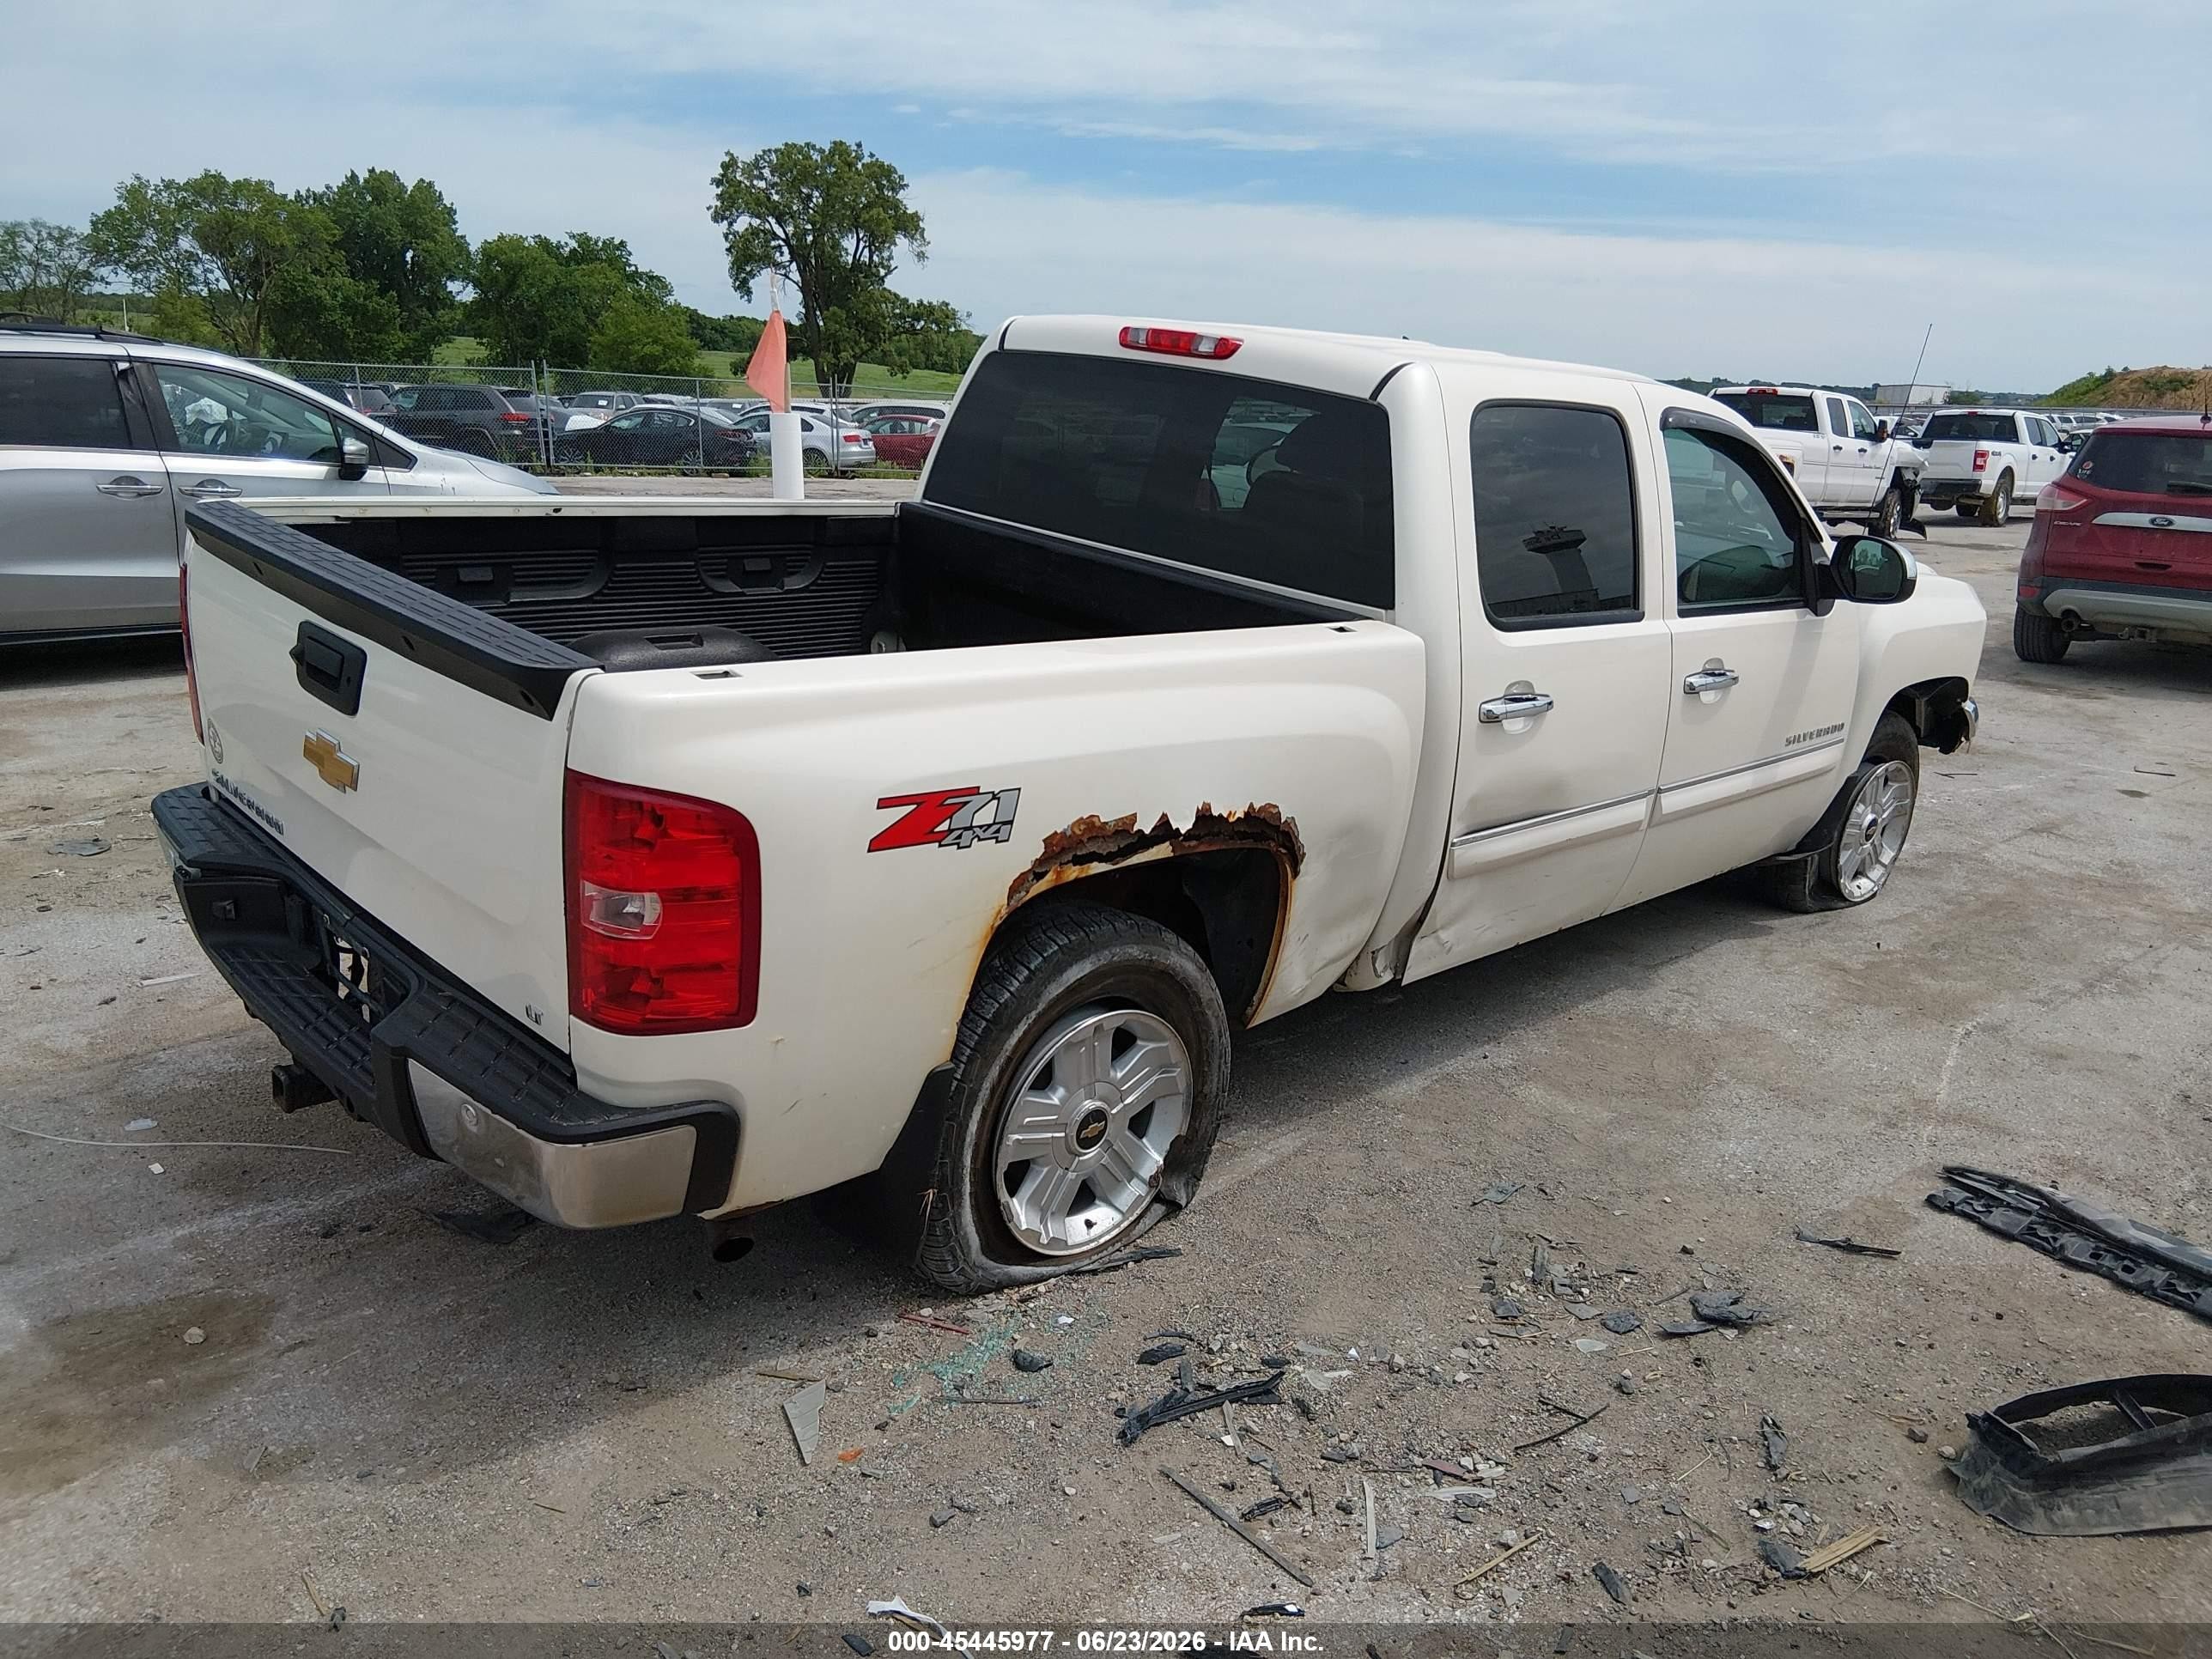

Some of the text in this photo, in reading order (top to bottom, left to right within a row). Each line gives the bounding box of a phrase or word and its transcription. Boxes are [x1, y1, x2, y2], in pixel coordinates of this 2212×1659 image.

[1784, 722, 1844, 747] SILVERADO
[867, 786, 1021, 853] Z71
[526, 1004, 544, 1025] LT
